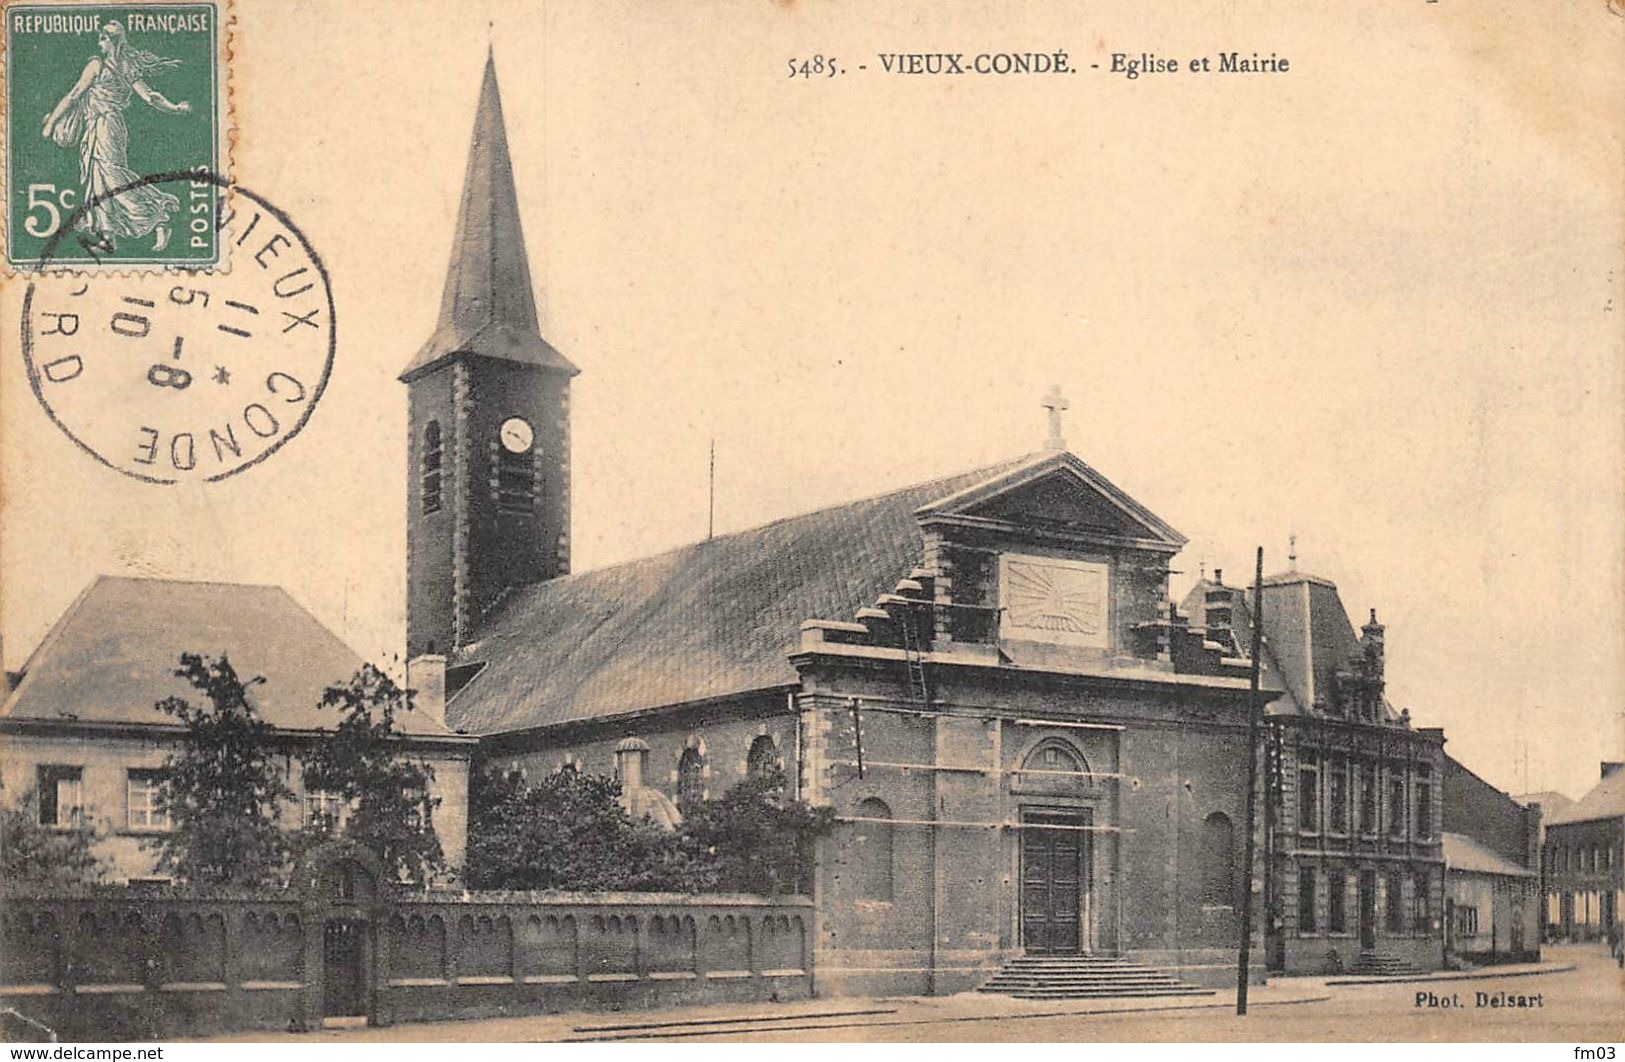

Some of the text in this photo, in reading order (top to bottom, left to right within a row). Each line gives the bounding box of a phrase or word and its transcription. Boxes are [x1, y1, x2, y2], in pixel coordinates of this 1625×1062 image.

[127, 14, 208, 34] FRANÇAISE
[787, 56, 847, 79] 5485.
[878, 49, 1077, 75] VIEUX-CONDÉ.
[1110, 53, 1179, 80] Eglise
[1189, 57, 1211, 74] et
[1218, 53, 1290, 74] Mairie
[190, 164, 209, 248] POSTES
[134, 372, 306, 471] CONDE
[1414, 992, 1544, 1008] Phot. Delsart
